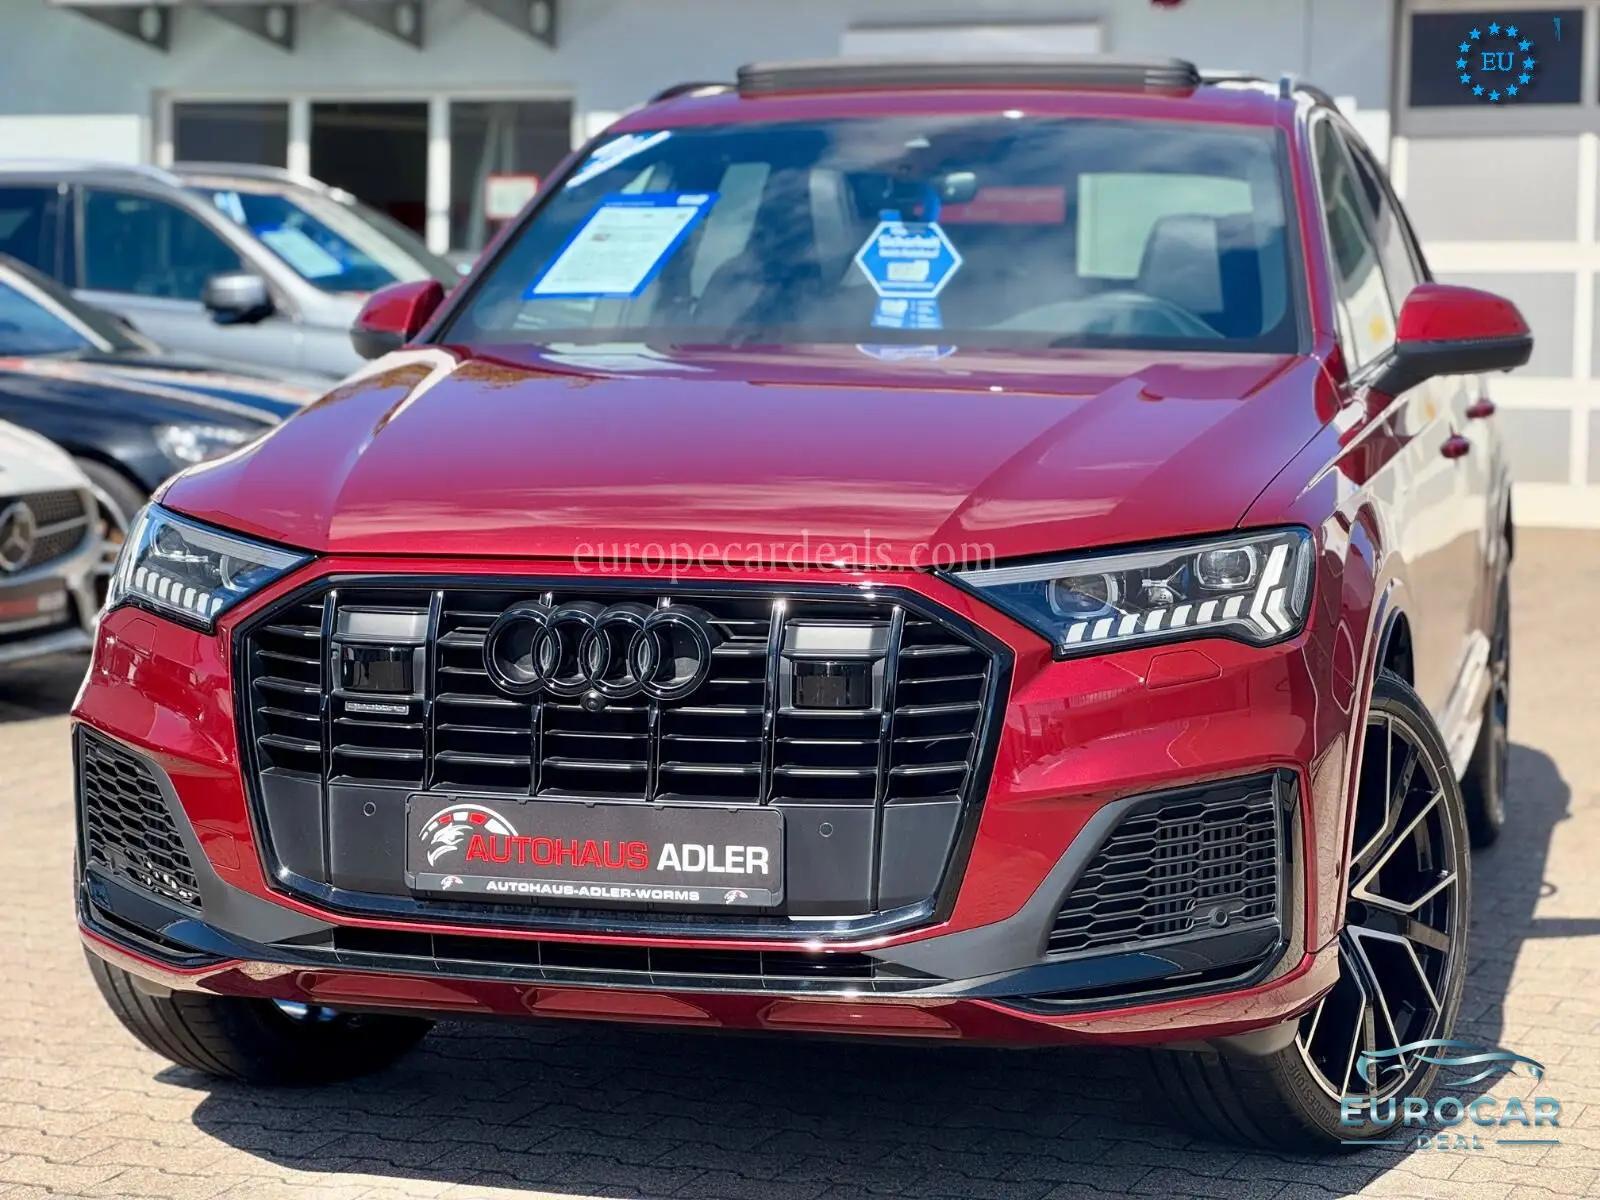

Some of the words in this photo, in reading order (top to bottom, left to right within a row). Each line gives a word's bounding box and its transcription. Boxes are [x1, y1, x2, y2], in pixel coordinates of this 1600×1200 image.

[465, 834, 649, 869] AUTOHAUS
[656, 843, 769, 874] ADLER
[485, 879, 700, 902] AUTOHAUS-ADLER-WORMS
